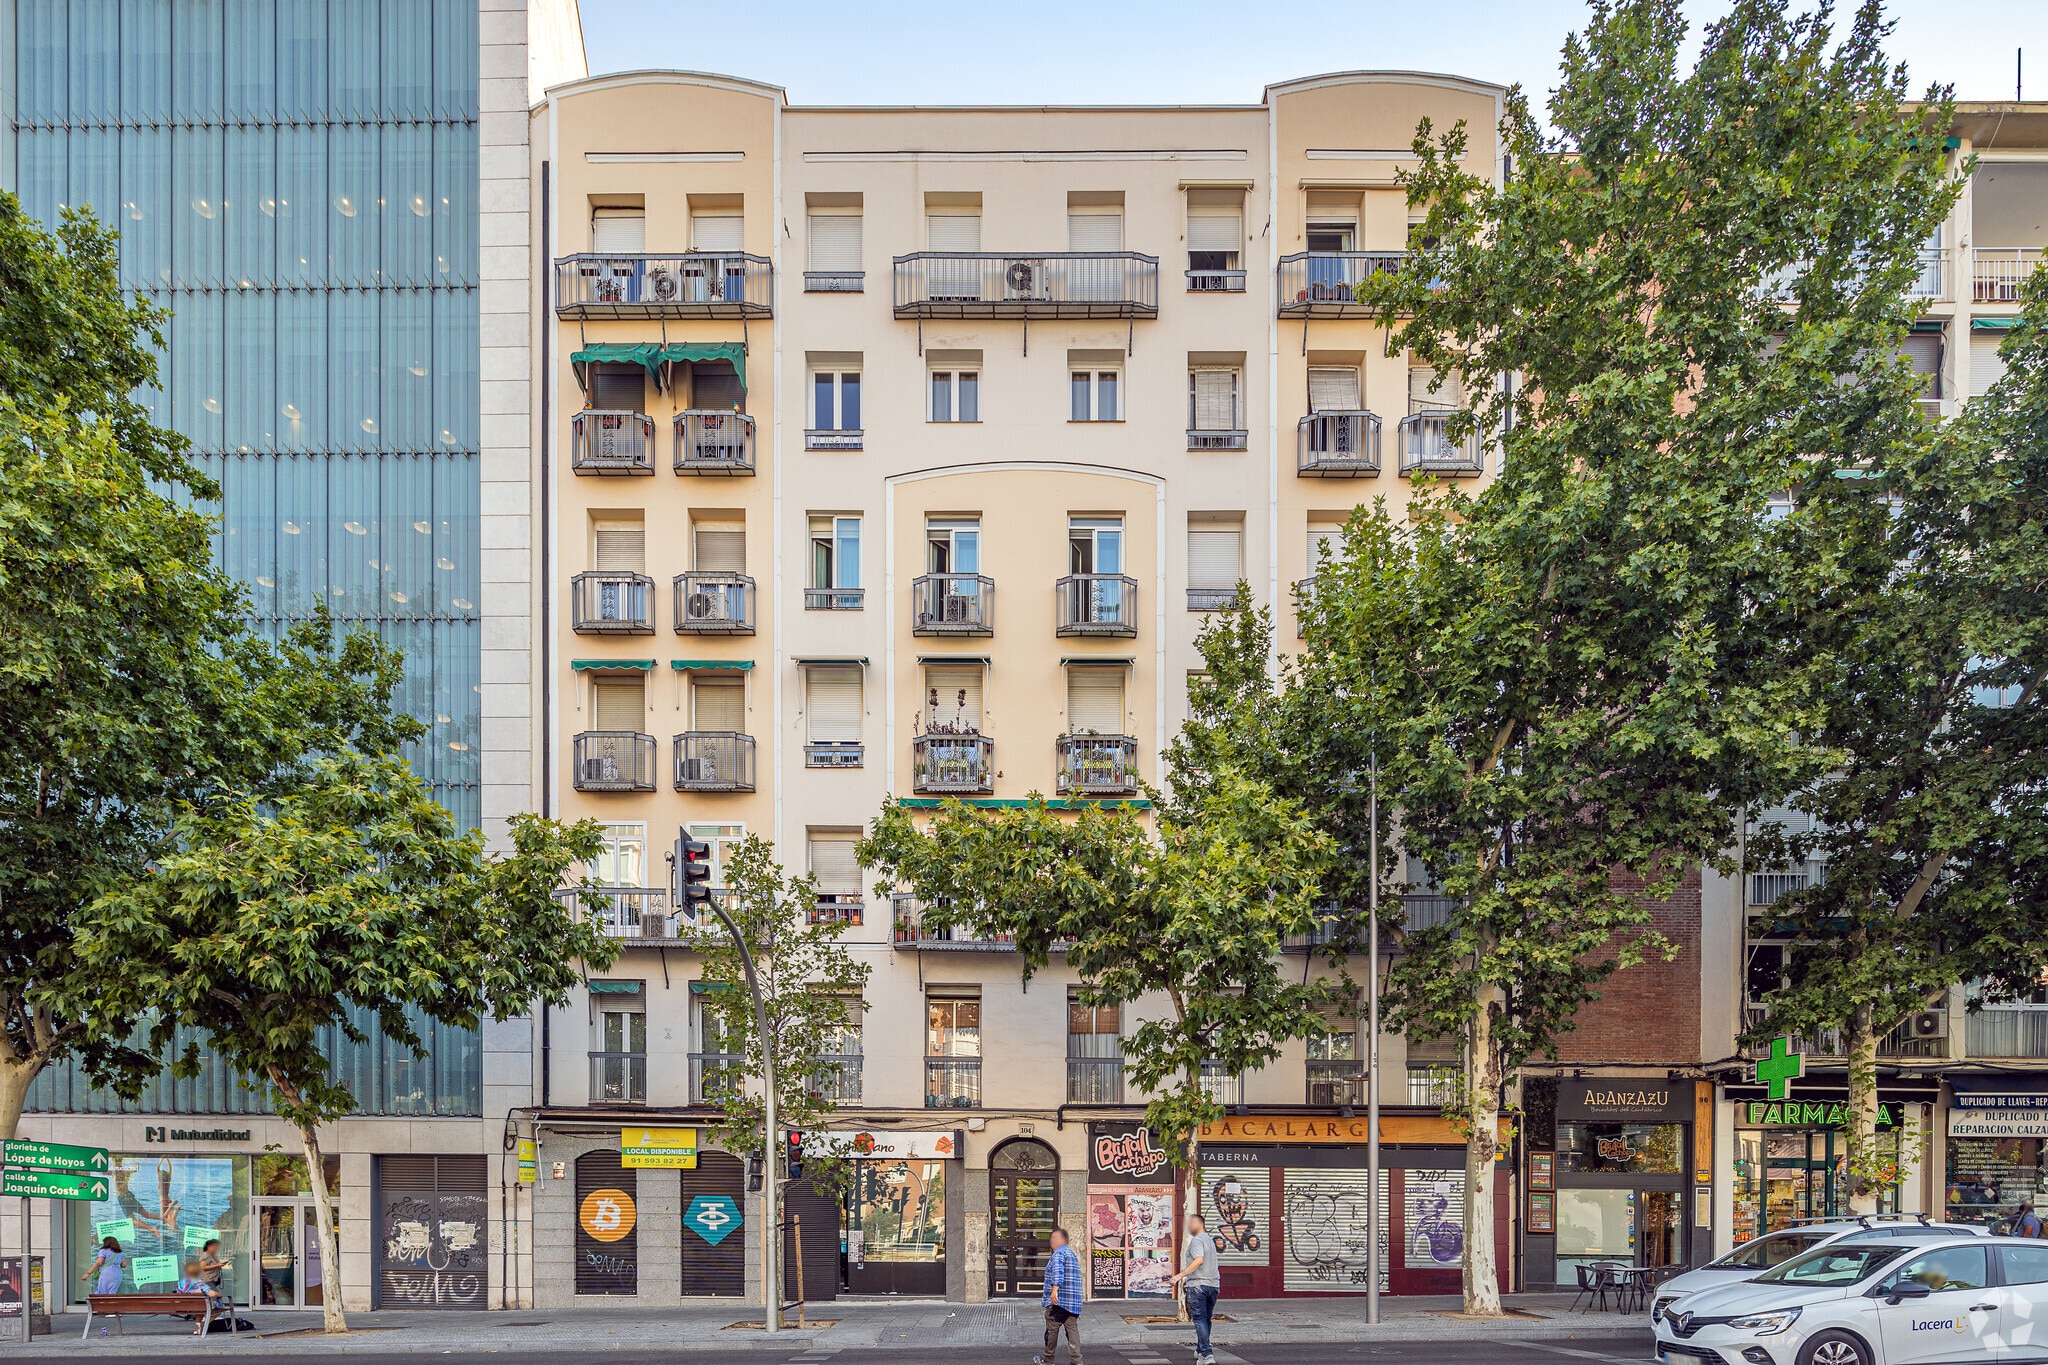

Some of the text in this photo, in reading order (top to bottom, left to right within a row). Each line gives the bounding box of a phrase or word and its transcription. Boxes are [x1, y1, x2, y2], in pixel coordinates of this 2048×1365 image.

[1960, 1097, 1996, 1106] DUPLICADO
[1997, 1097, 2006, 1106] DE
[2008, 1097, 2030, 1106] LLAVES
[2035, 1097, 2048, 1106] REP
[1748, 1102, 1893, 1125] FARMAA
[1985, 1112, 2040, 1121] DUPLICADO
[1201, 1119, 1385, 1138] BACALARG
[1953, 1125, 2048, 1134] REPARACION CALZA
[171, 1129, 251, 1141] Mutualidad
[5, 1143, 50, 1153] glorieta de
[1099, 1130, 1148, 1167] Brutal
[5, 1152, 86, 1168] López de Hoyos
[1113, 1151, 1165, 1171] Cachopo
[1201, 1152, 1259, 1162] TABERNA
[1135, 1165, 1151, 1174] .com
[5, 1173, 38, 1182] calle de
[49, 1185, 79, 1196] Costa
[1912, 1319, 1953, 1331] Lacera
